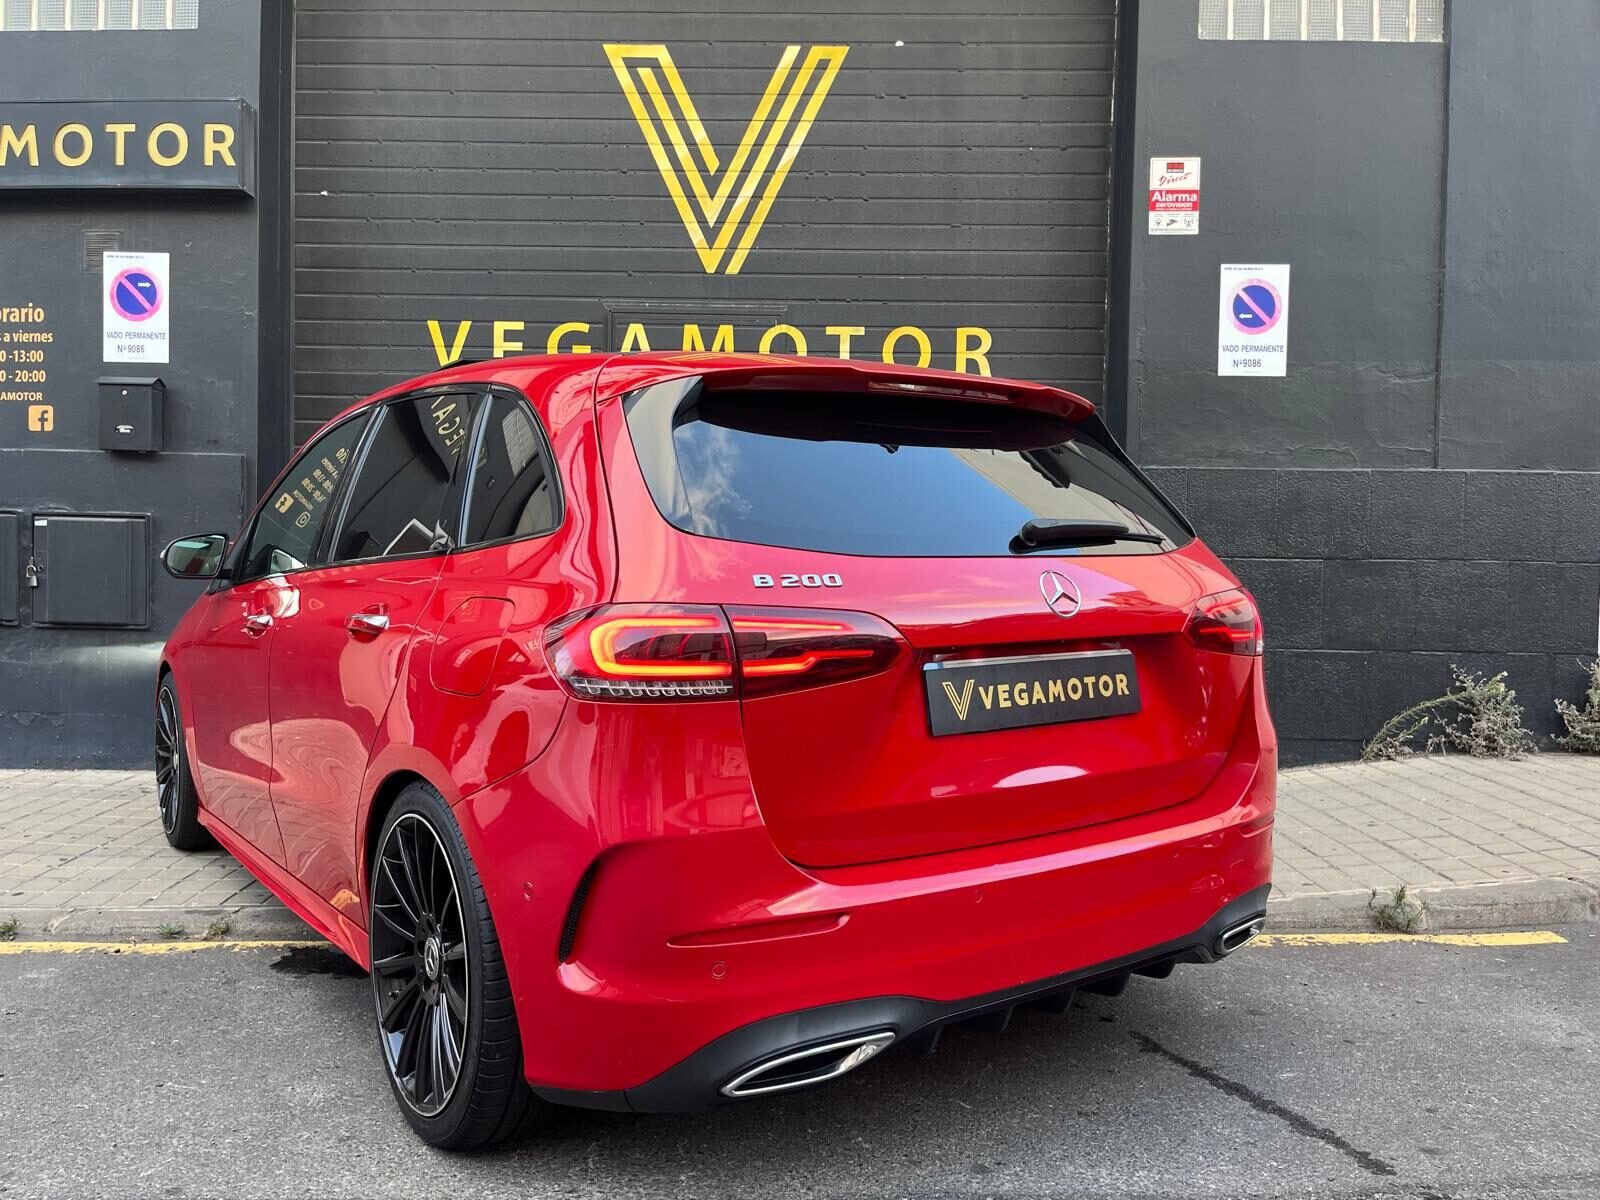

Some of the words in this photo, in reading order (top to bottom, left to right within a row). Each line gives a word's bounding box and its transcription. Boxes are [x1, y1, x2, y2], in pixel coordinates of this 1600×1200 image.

[0, 123, 237, 167] MOTOR
[1159, 171, 1193, 187] Direct
[1151, 190, 1198, 202] Alarma
[3, 332, 10, 343] a
[12, 329, 54, 343] viernes
[106, 331, 123, 339] VADO
[125, 331, 166, 340] PERMANENTE
[1221, 344, 1239, 353] VADO
[1241, 344, 1285, 353] PERMANENTE
[14, 369, 46, 382] 20:00
[0, 391, 43, 401] AMOTOR
[752, 574, 775, 588] B
[780, 574, 843, 588] 200
[978, 673, 1130, 710] VEGAMOTOR
